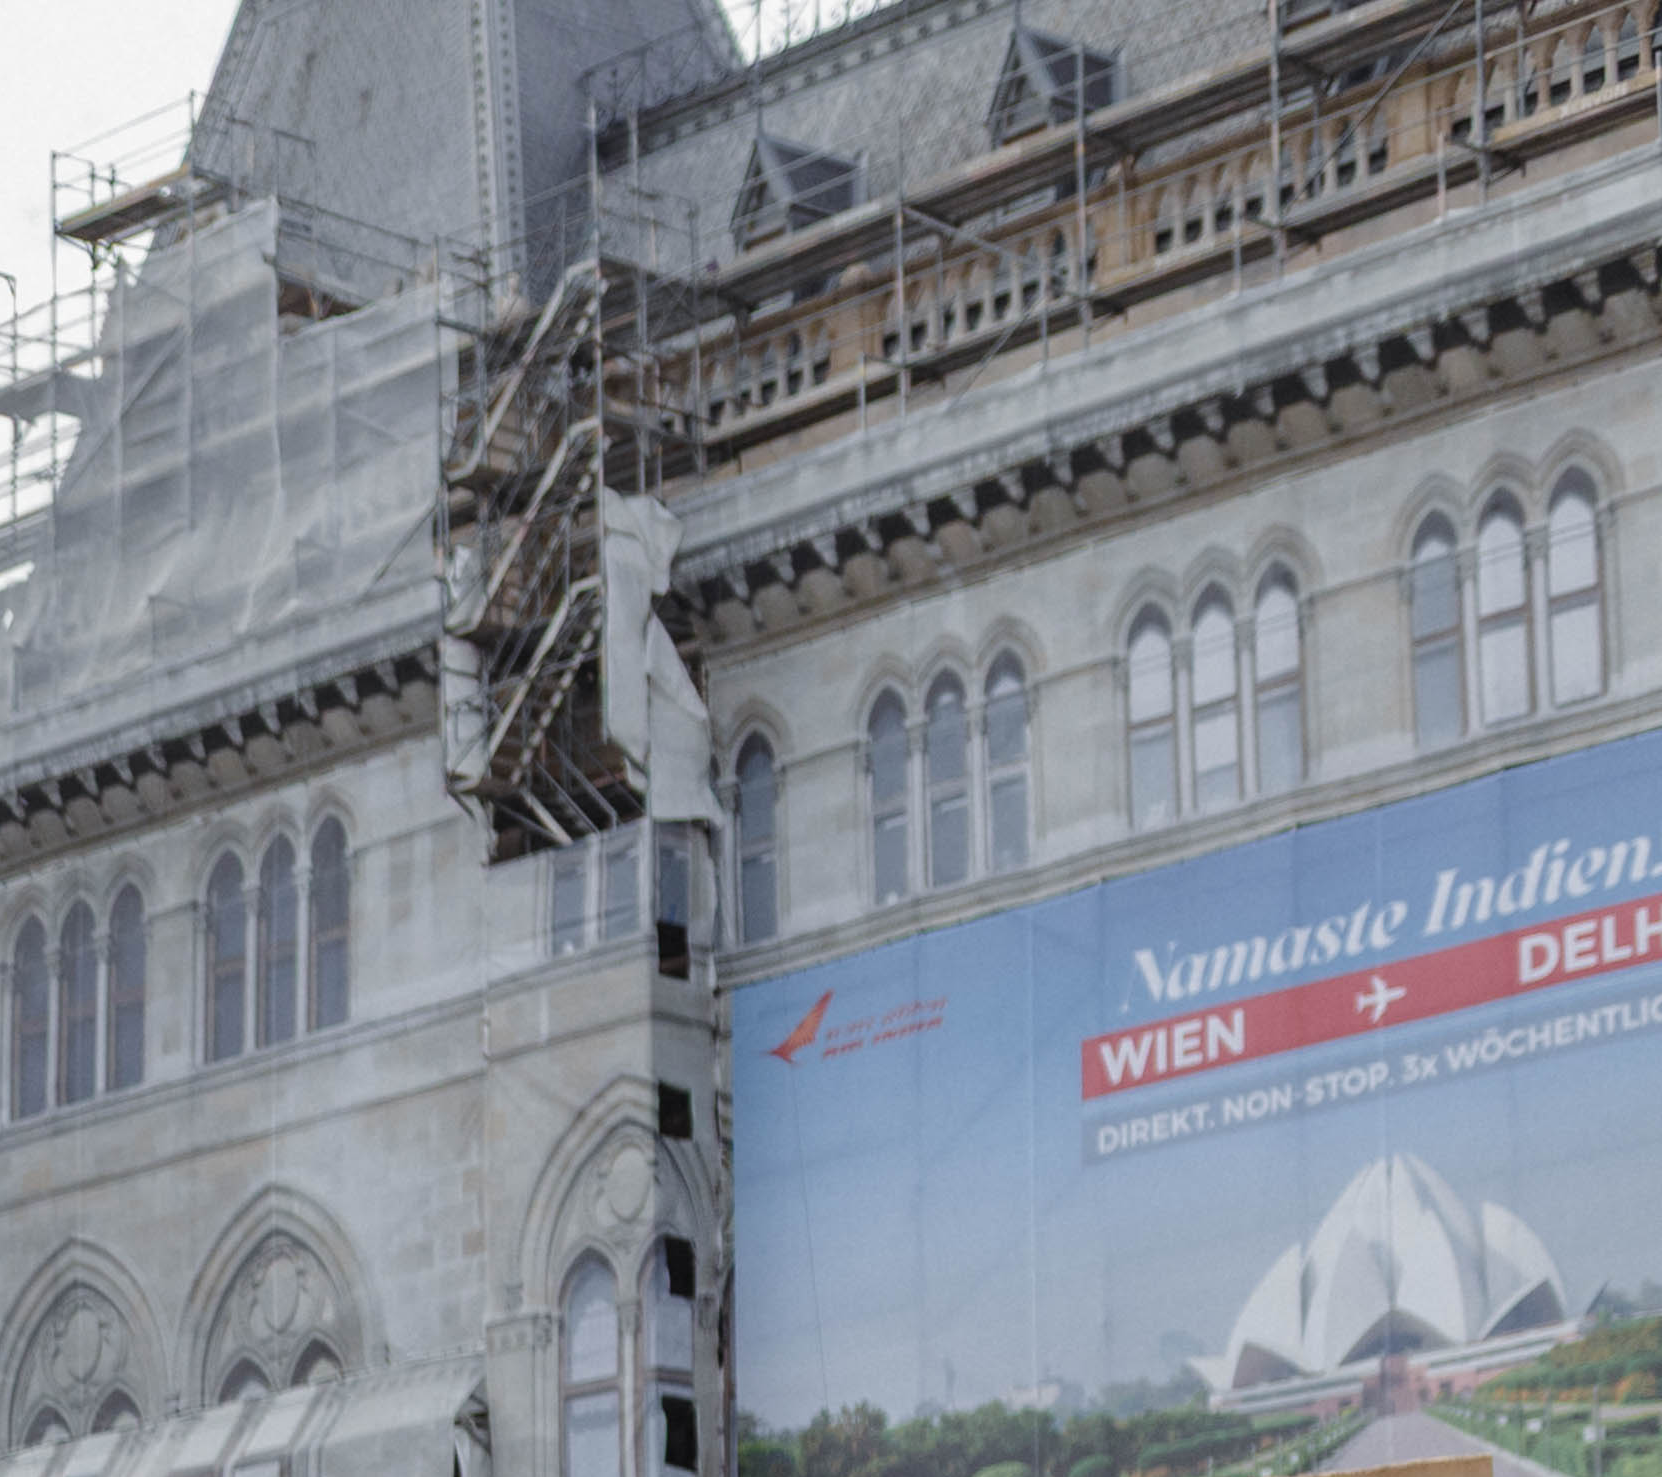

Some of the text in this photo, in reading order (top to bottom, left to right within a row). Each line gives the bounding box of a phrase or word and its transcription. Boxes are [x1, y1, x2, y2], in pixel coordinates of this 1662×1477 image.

[1120, 834, 1662, 1015] Namaste Indien
[1099, 1008, 1246, 1087] WIEN
[1096, 1104, 1215, 1156] DIREKT.
[1221, 1061, 1394, 1126] NON-STOP.
[1402, 1051, 1439, 1085] 3x
